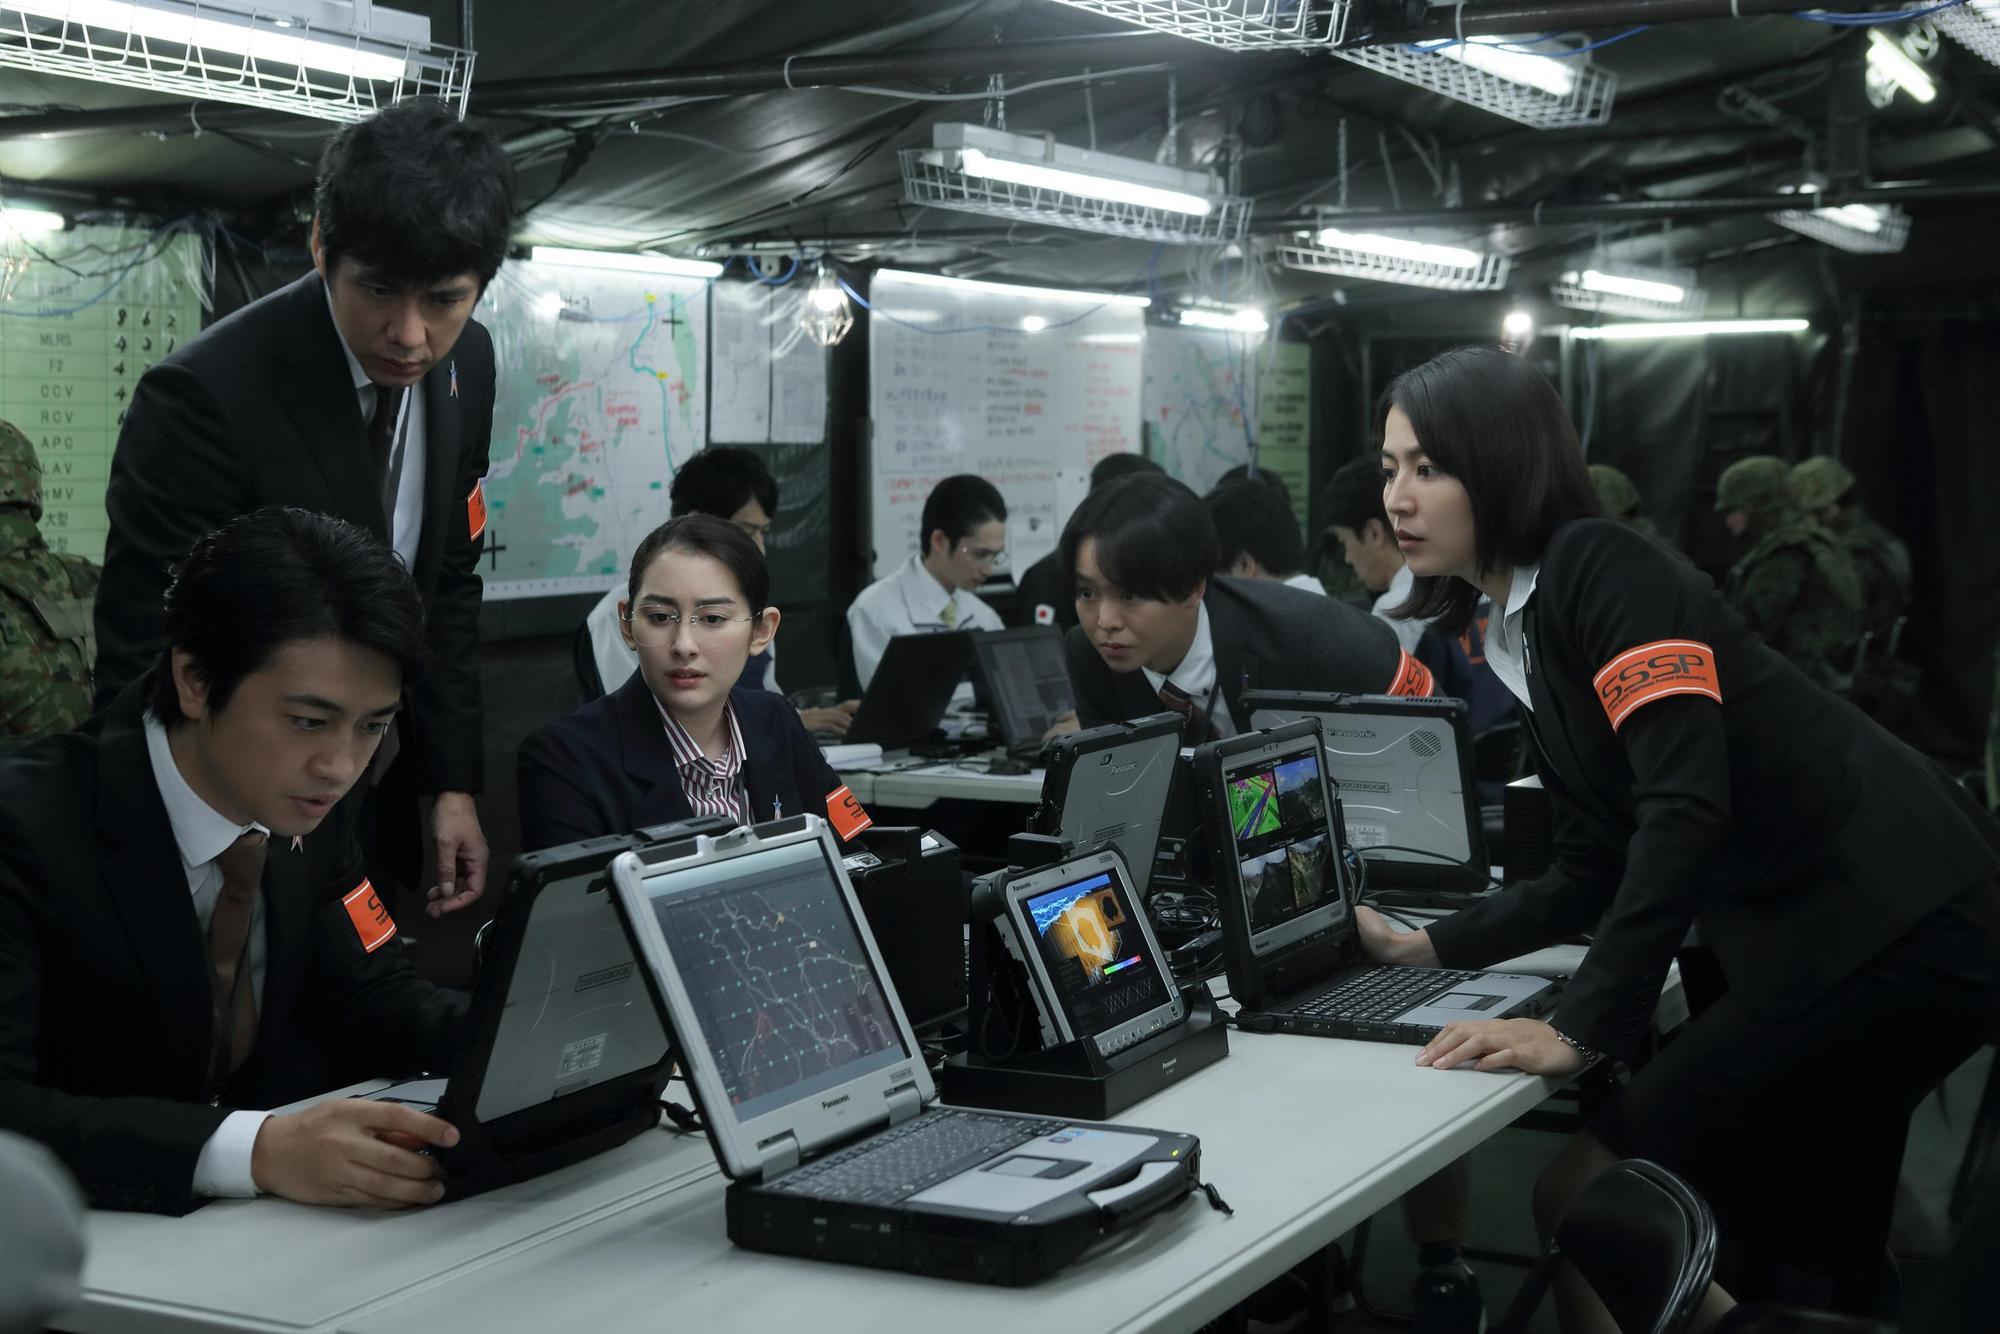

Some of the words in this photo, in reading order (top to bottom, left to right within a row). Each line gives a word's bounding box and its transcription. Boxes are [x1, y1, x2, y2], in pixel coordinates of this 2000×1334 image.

[39, 333, 72, 347] MLRS
[1602, 653, 1704, 710] SSSP
[1327, 728, 1377, 738] Panasonic
[1339, 782, 1387, 791] OUGHBOOK
